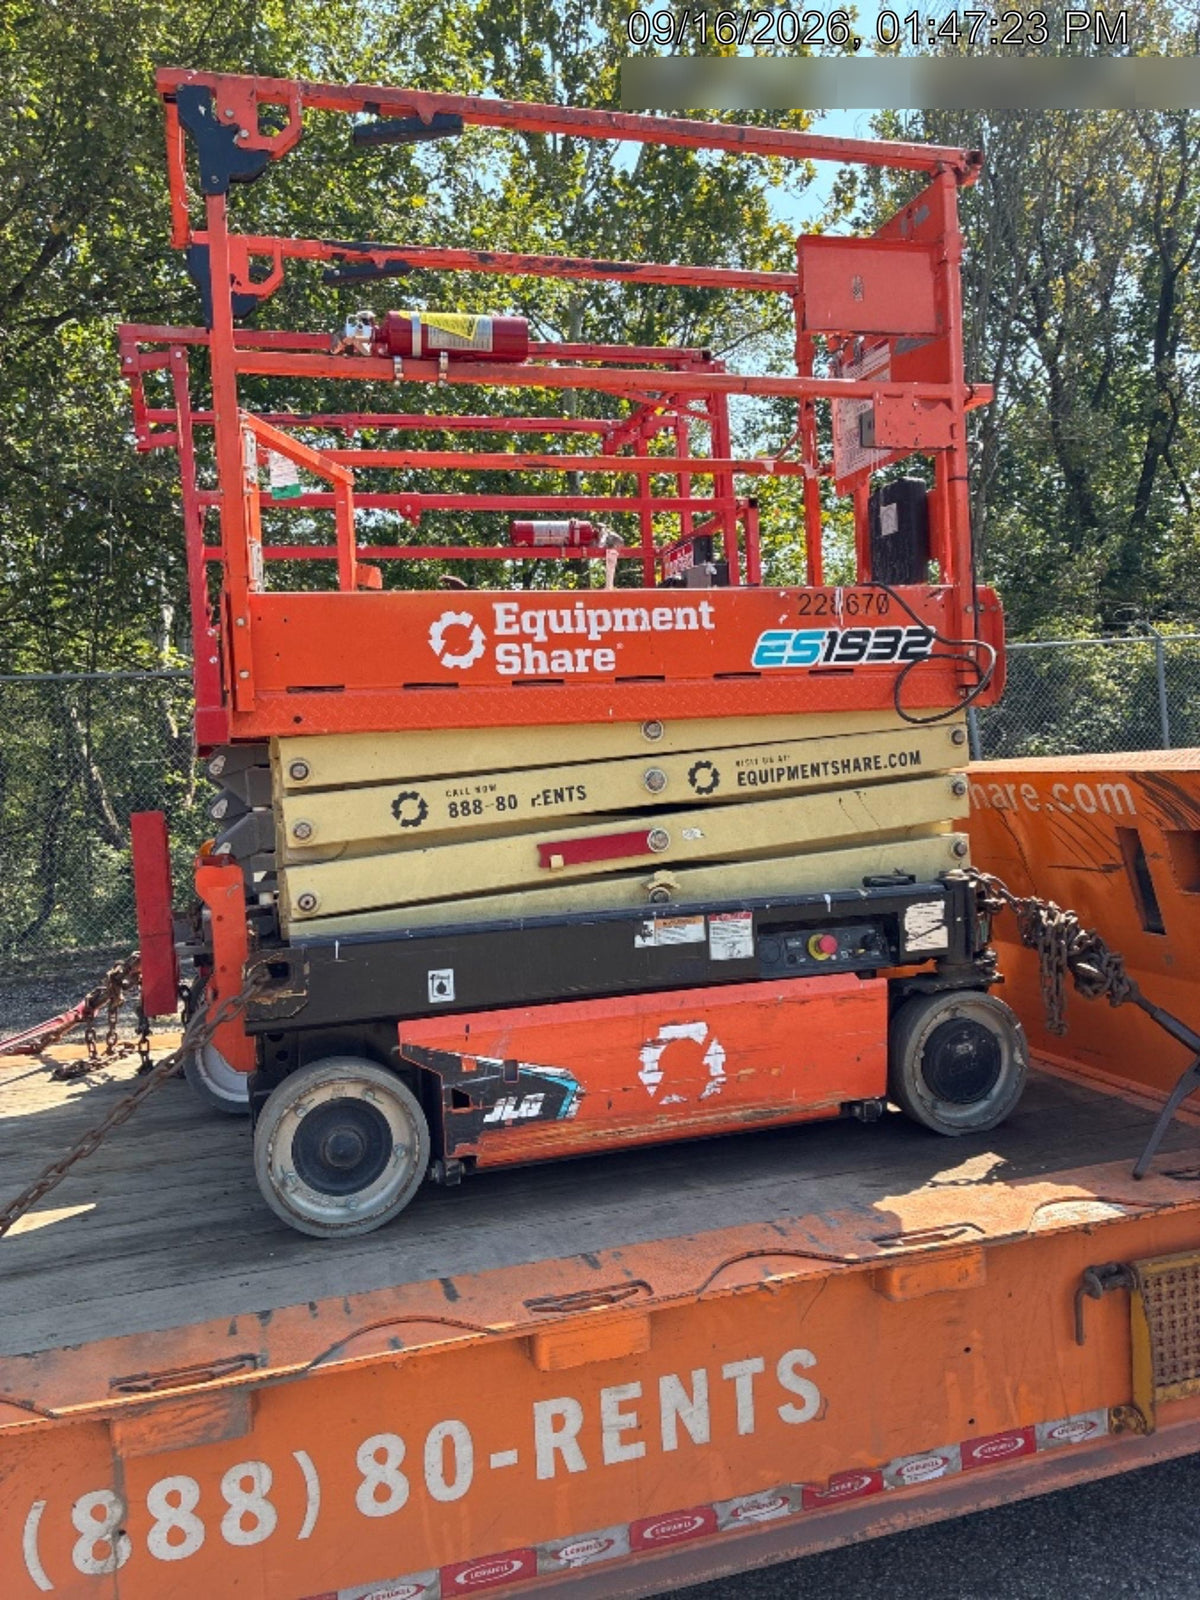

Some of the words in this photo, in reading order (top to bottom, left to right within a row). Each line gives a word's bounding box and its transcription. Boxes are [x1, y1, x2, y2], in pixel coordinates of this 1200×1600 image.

[492, 600, 715, 642] Equipment
[495, 643, 616, 674] Share
[753, 626, 937, 668] ES1932
[737, 750, 922, 786] EQUIPMENTSHARE.COM
[445, 787, 471, 798] CALL
[22, 1450, 321, 1592] (888)
[355, 1348, 821, 1518] 80-RENTS
